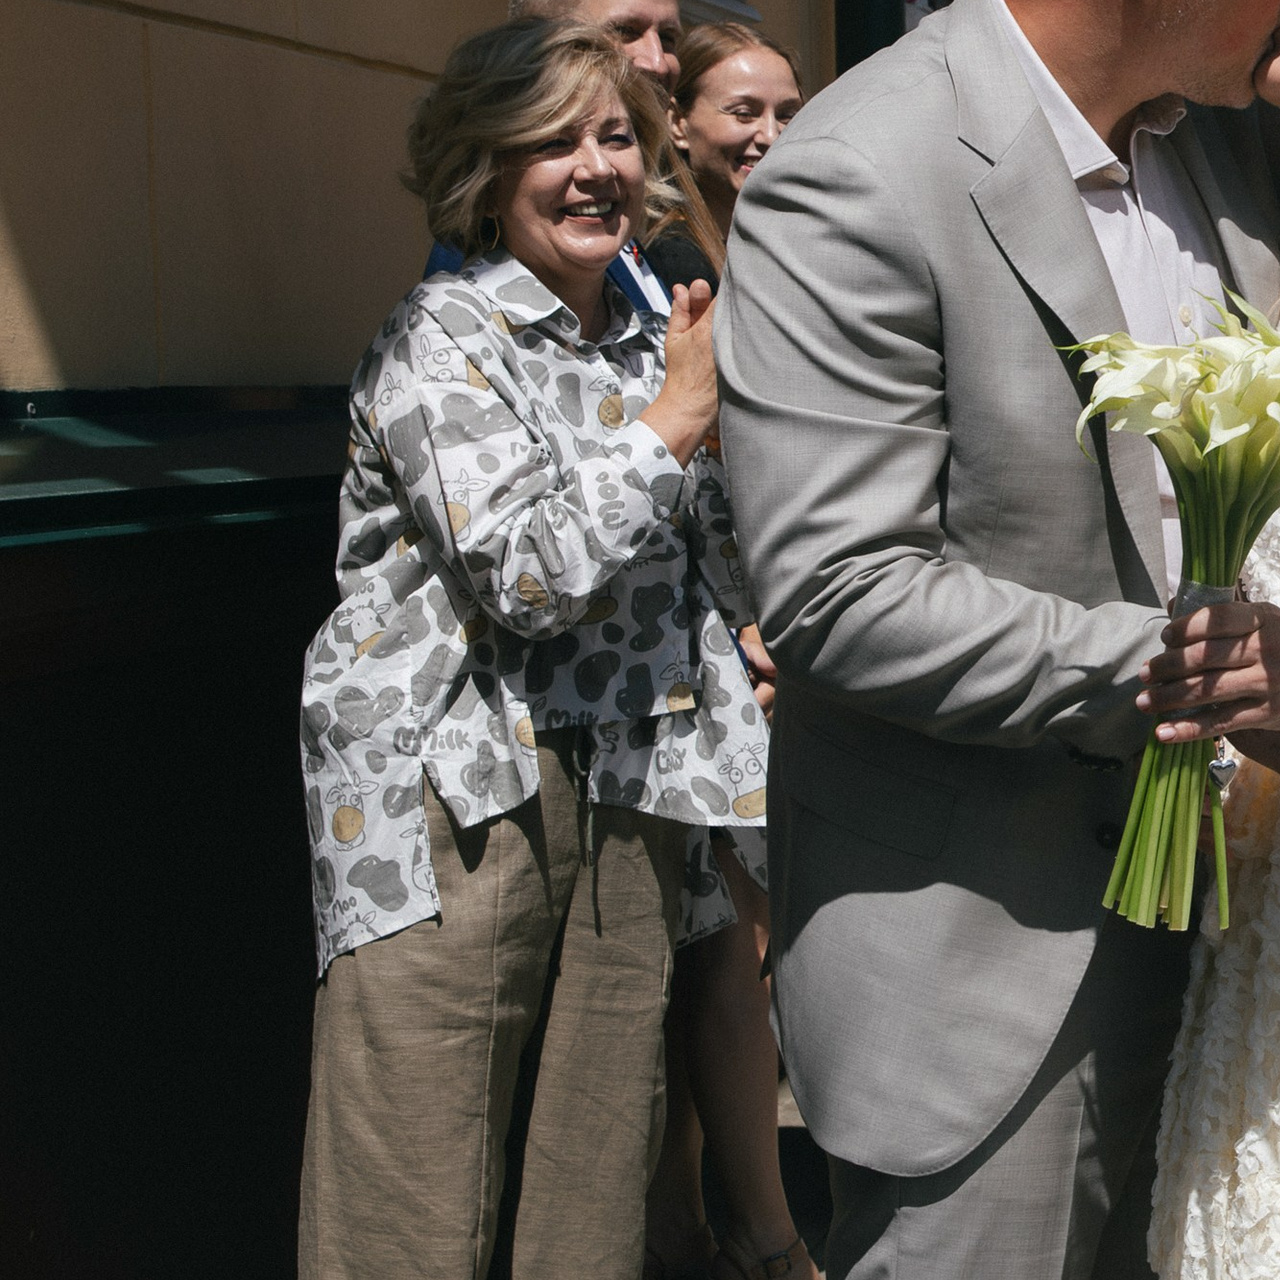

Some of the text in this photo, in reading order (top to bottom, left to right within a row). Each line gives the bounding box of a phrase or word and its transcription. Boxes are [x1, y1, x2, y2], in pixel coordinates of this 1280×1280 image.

[355, 581, 375, 597] oo
[413, 725, 473, 754] Milk
[332, 896, 358, 921] Moo
